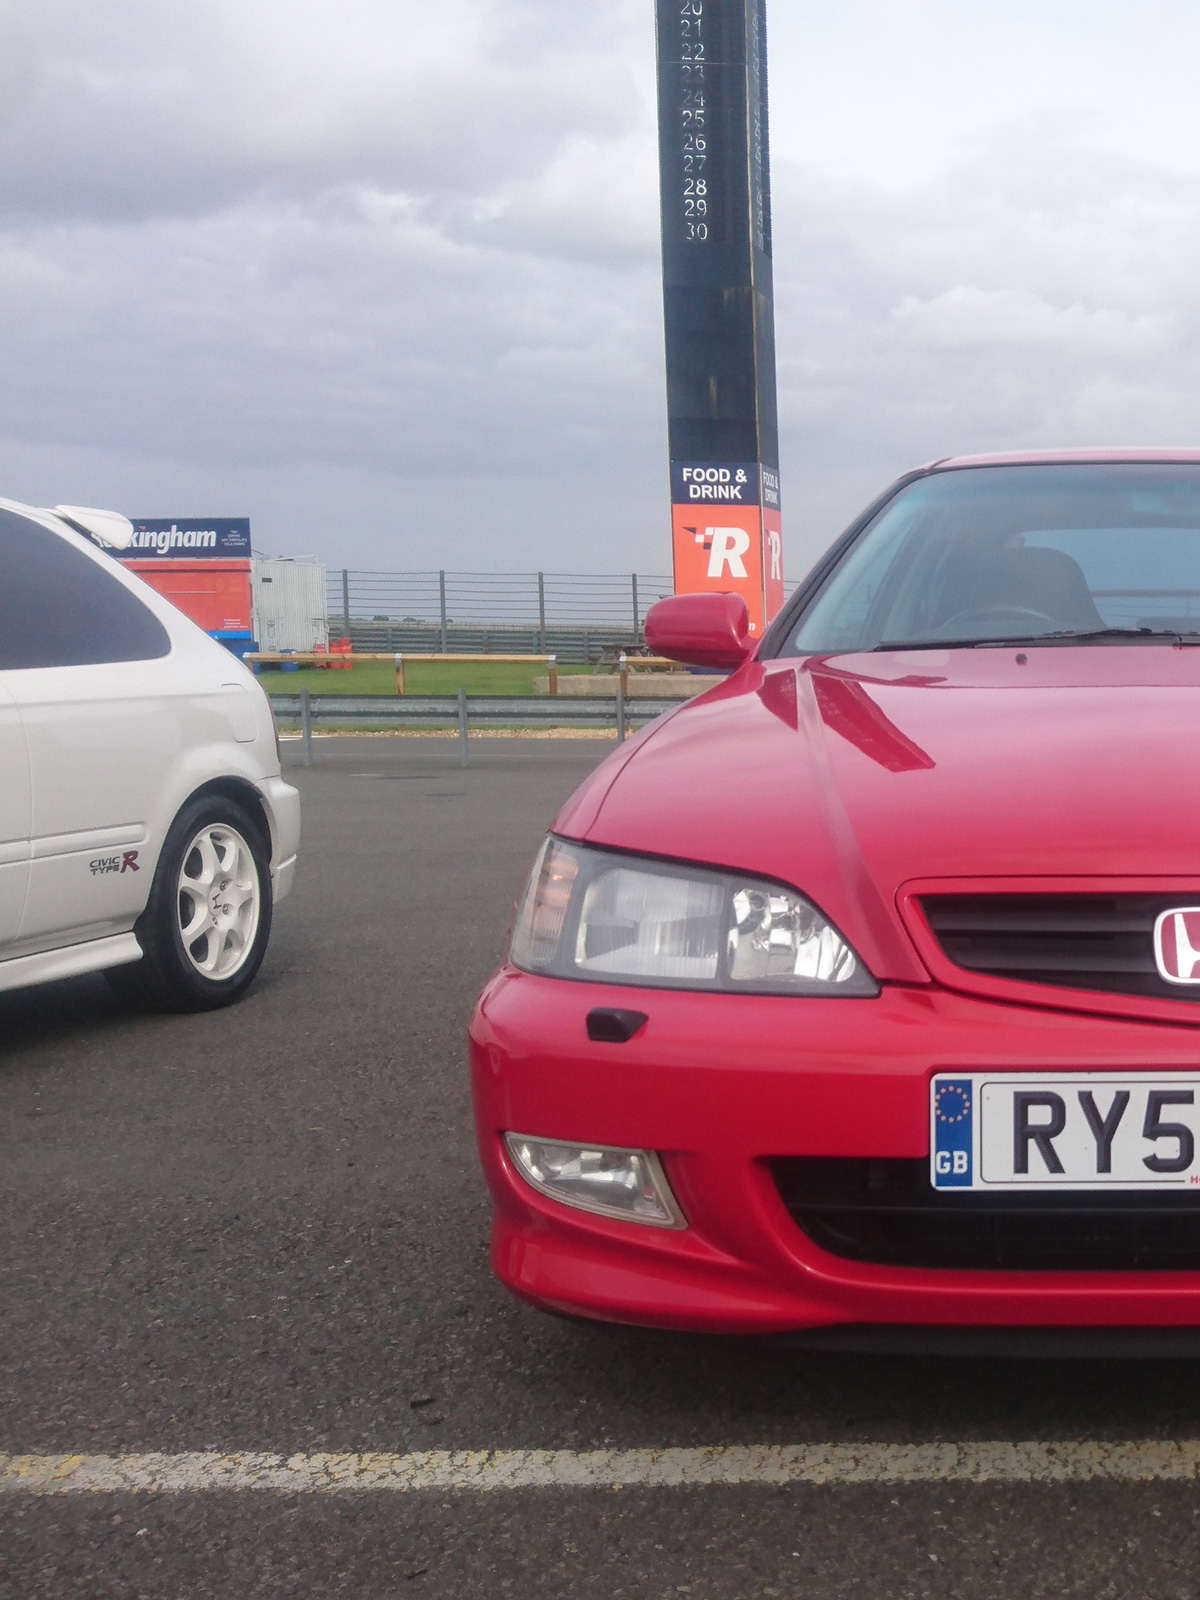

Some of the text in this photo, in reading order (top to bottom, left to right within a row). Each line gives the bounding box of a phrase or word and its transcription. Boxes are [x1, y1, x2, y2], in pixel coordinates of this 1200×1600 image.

[680, 0, 703, 16] 20
[680, 19, 702, 37] 21
[681, 43, 705, 61] 22
[682, 110, 706, 127] 25
[683, 133, 707, 151] 26
[683, 155, 707, 172] 27
[683, 178, 708, 196] 28
[684, 199, 707, 217] 29
[686, 222, 708, 240] 30
[682, 467, 748, 483] FOOD &
[763, 471, 774, 489] FOOD
[689, 485, 743, 499] DRINK
[764, 488, 779, 505] DRINK
[90, 524, 217, 554] kingham
[89, 856, 120, 868] CIVIC
[90, 850, 141, 875] TYPE R
[935, 1150, 969, 1175] GB
